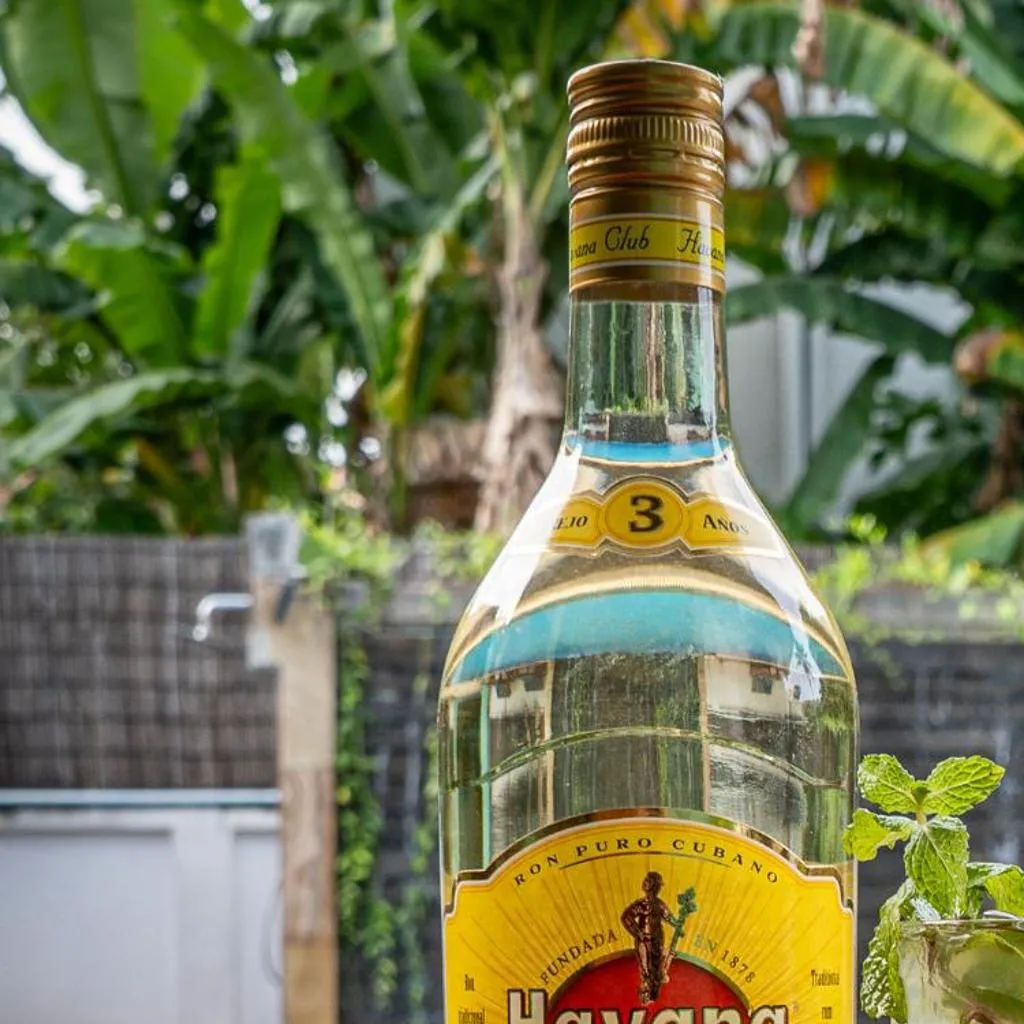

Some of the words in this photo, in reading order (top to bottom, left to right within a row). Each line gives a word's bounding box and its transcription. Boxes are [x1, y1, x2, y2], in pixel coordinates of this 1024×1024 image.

[604, 225, 649, 251] Club
[628, 494, 664, 533] 3
[513, 855, 560, 887] RON
[576, 838, 652, 858] PURO
[672, 839, 780, 884] CUBANO
[539, 929, 618, 986] FUNDADA
[721, 949, 756, 984] 1878
